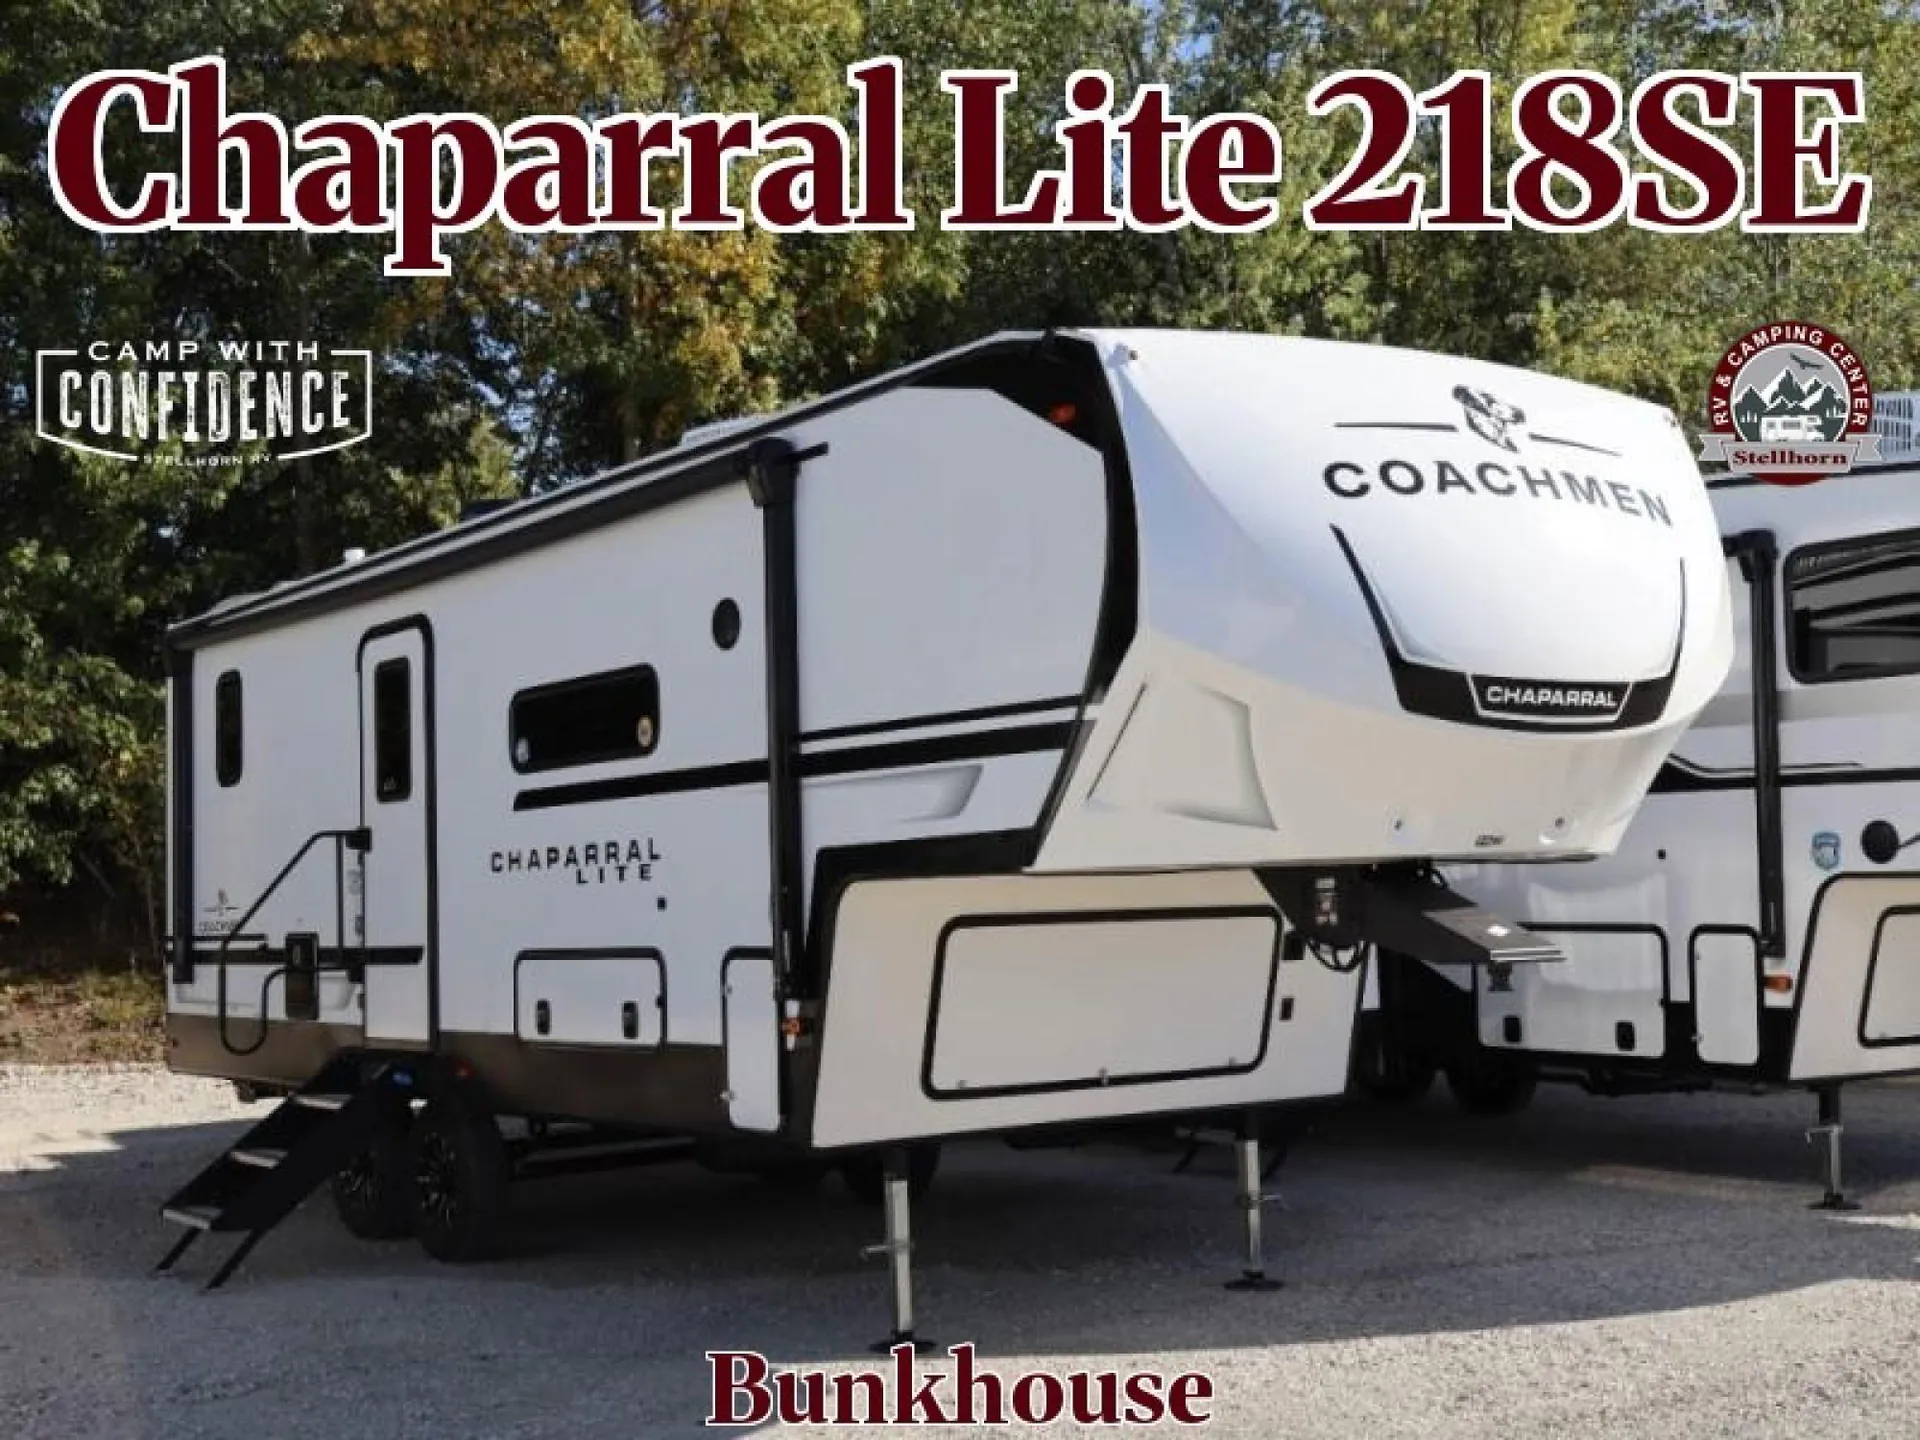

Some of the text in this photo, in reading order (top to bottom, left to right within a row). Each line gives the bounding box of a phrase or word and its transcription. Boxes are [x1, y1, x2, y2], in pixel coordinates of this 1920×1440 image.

[1323, 459, 1674, 527] COACHMEN
[1485, 685, 1618, 708] CHAPARRAL
[490, 837, 662, 874] CHAPARRAL
[575, 863, 653, 884] LITE
